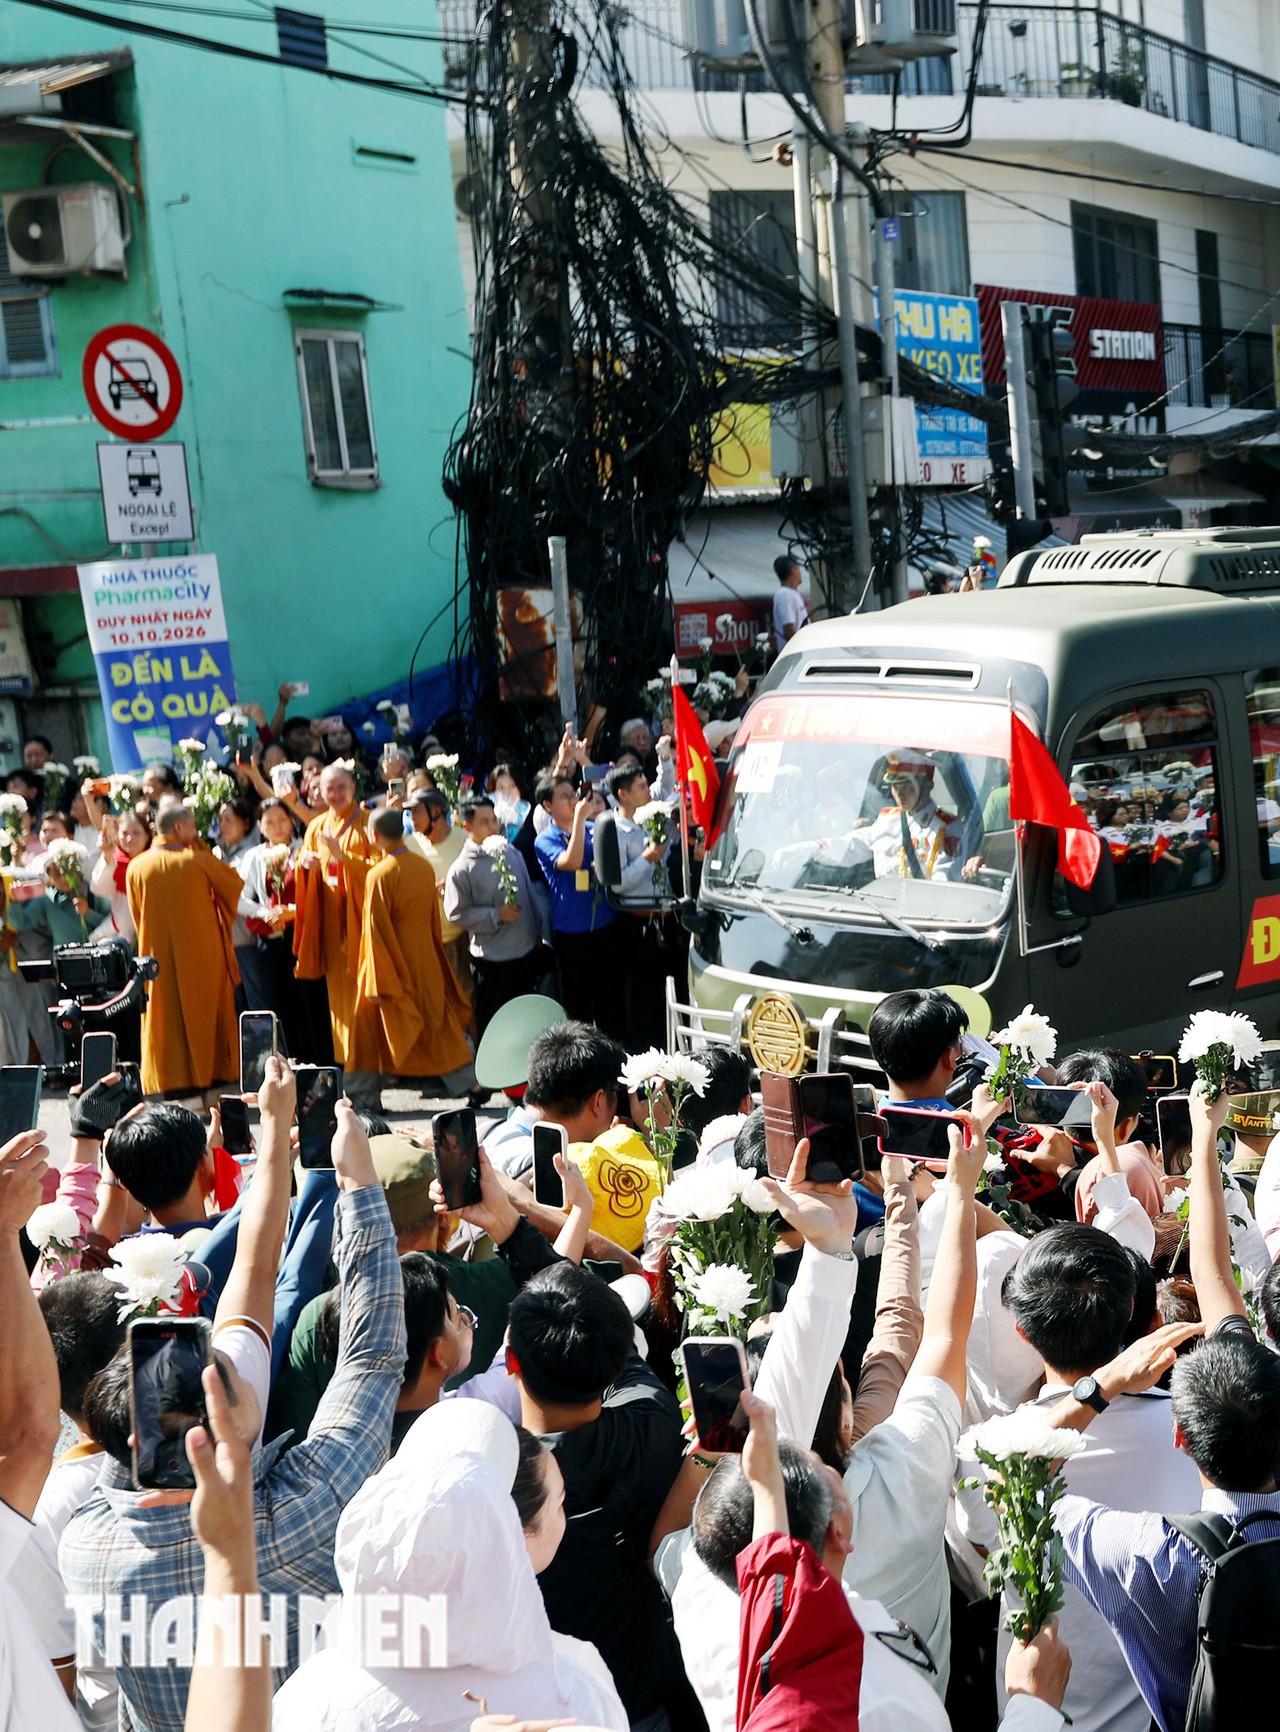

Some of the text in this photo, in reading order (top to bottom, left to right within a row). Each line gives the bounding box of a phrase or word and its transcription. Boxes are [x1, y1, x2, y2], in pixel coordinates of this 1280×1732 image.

[938, 302, 972, 343] HÀ
[1090, 329, 1157, 361] STATION
[956, 352, 982, 384] XE
[951, 462, 966, 483] XE
[130, 522, 169, 536] Except
[101, 569, 138, 586] NHÀ
[94, 580, 211, 606] Pharmacity
[97, 614, 126, 629] DUY
[173, 607, 212, 622] NGÀY
[110, 625, 206, 645] 10.10.2026
[111, 648, 222, 687] ĐẾN LÀ
[162, 684, 231, 719] QUÀ
[104, 996, 132, 1017] RONIN
